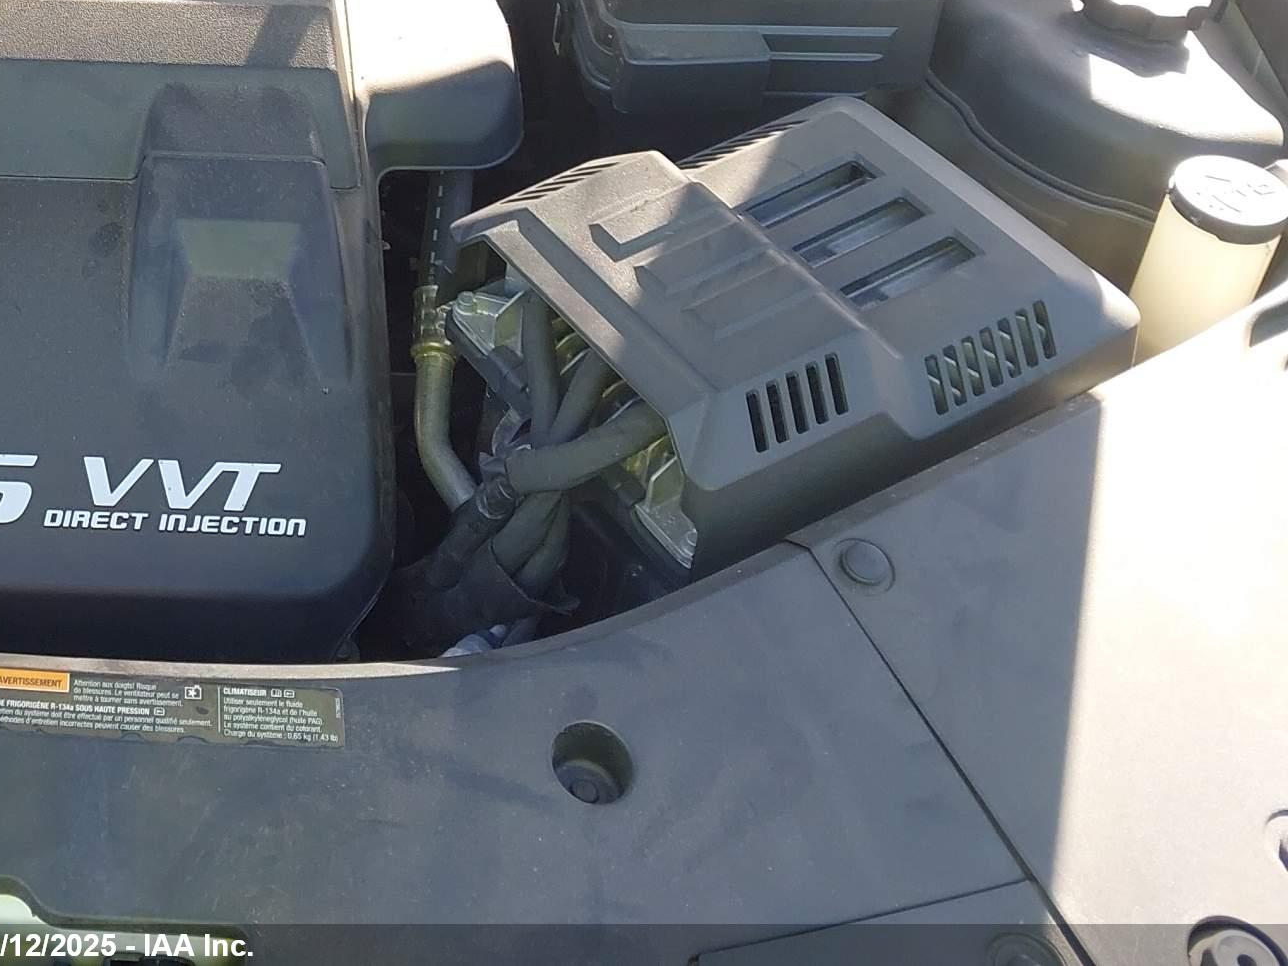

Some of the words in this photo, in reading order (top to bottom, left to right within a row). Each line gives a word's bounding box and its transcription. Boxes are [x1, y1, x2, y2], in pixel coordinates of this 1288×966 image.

[83, 456, 282, 511] VVT
[44, 510, 148, 530] DIRECT
[158, 514, 306, 536] INJECTION
[223, 688, 267, 696] CLIMATISEUR
[94, 706, 116, 714] HAUTE
[117, 706, 150, 716] PRESSION
